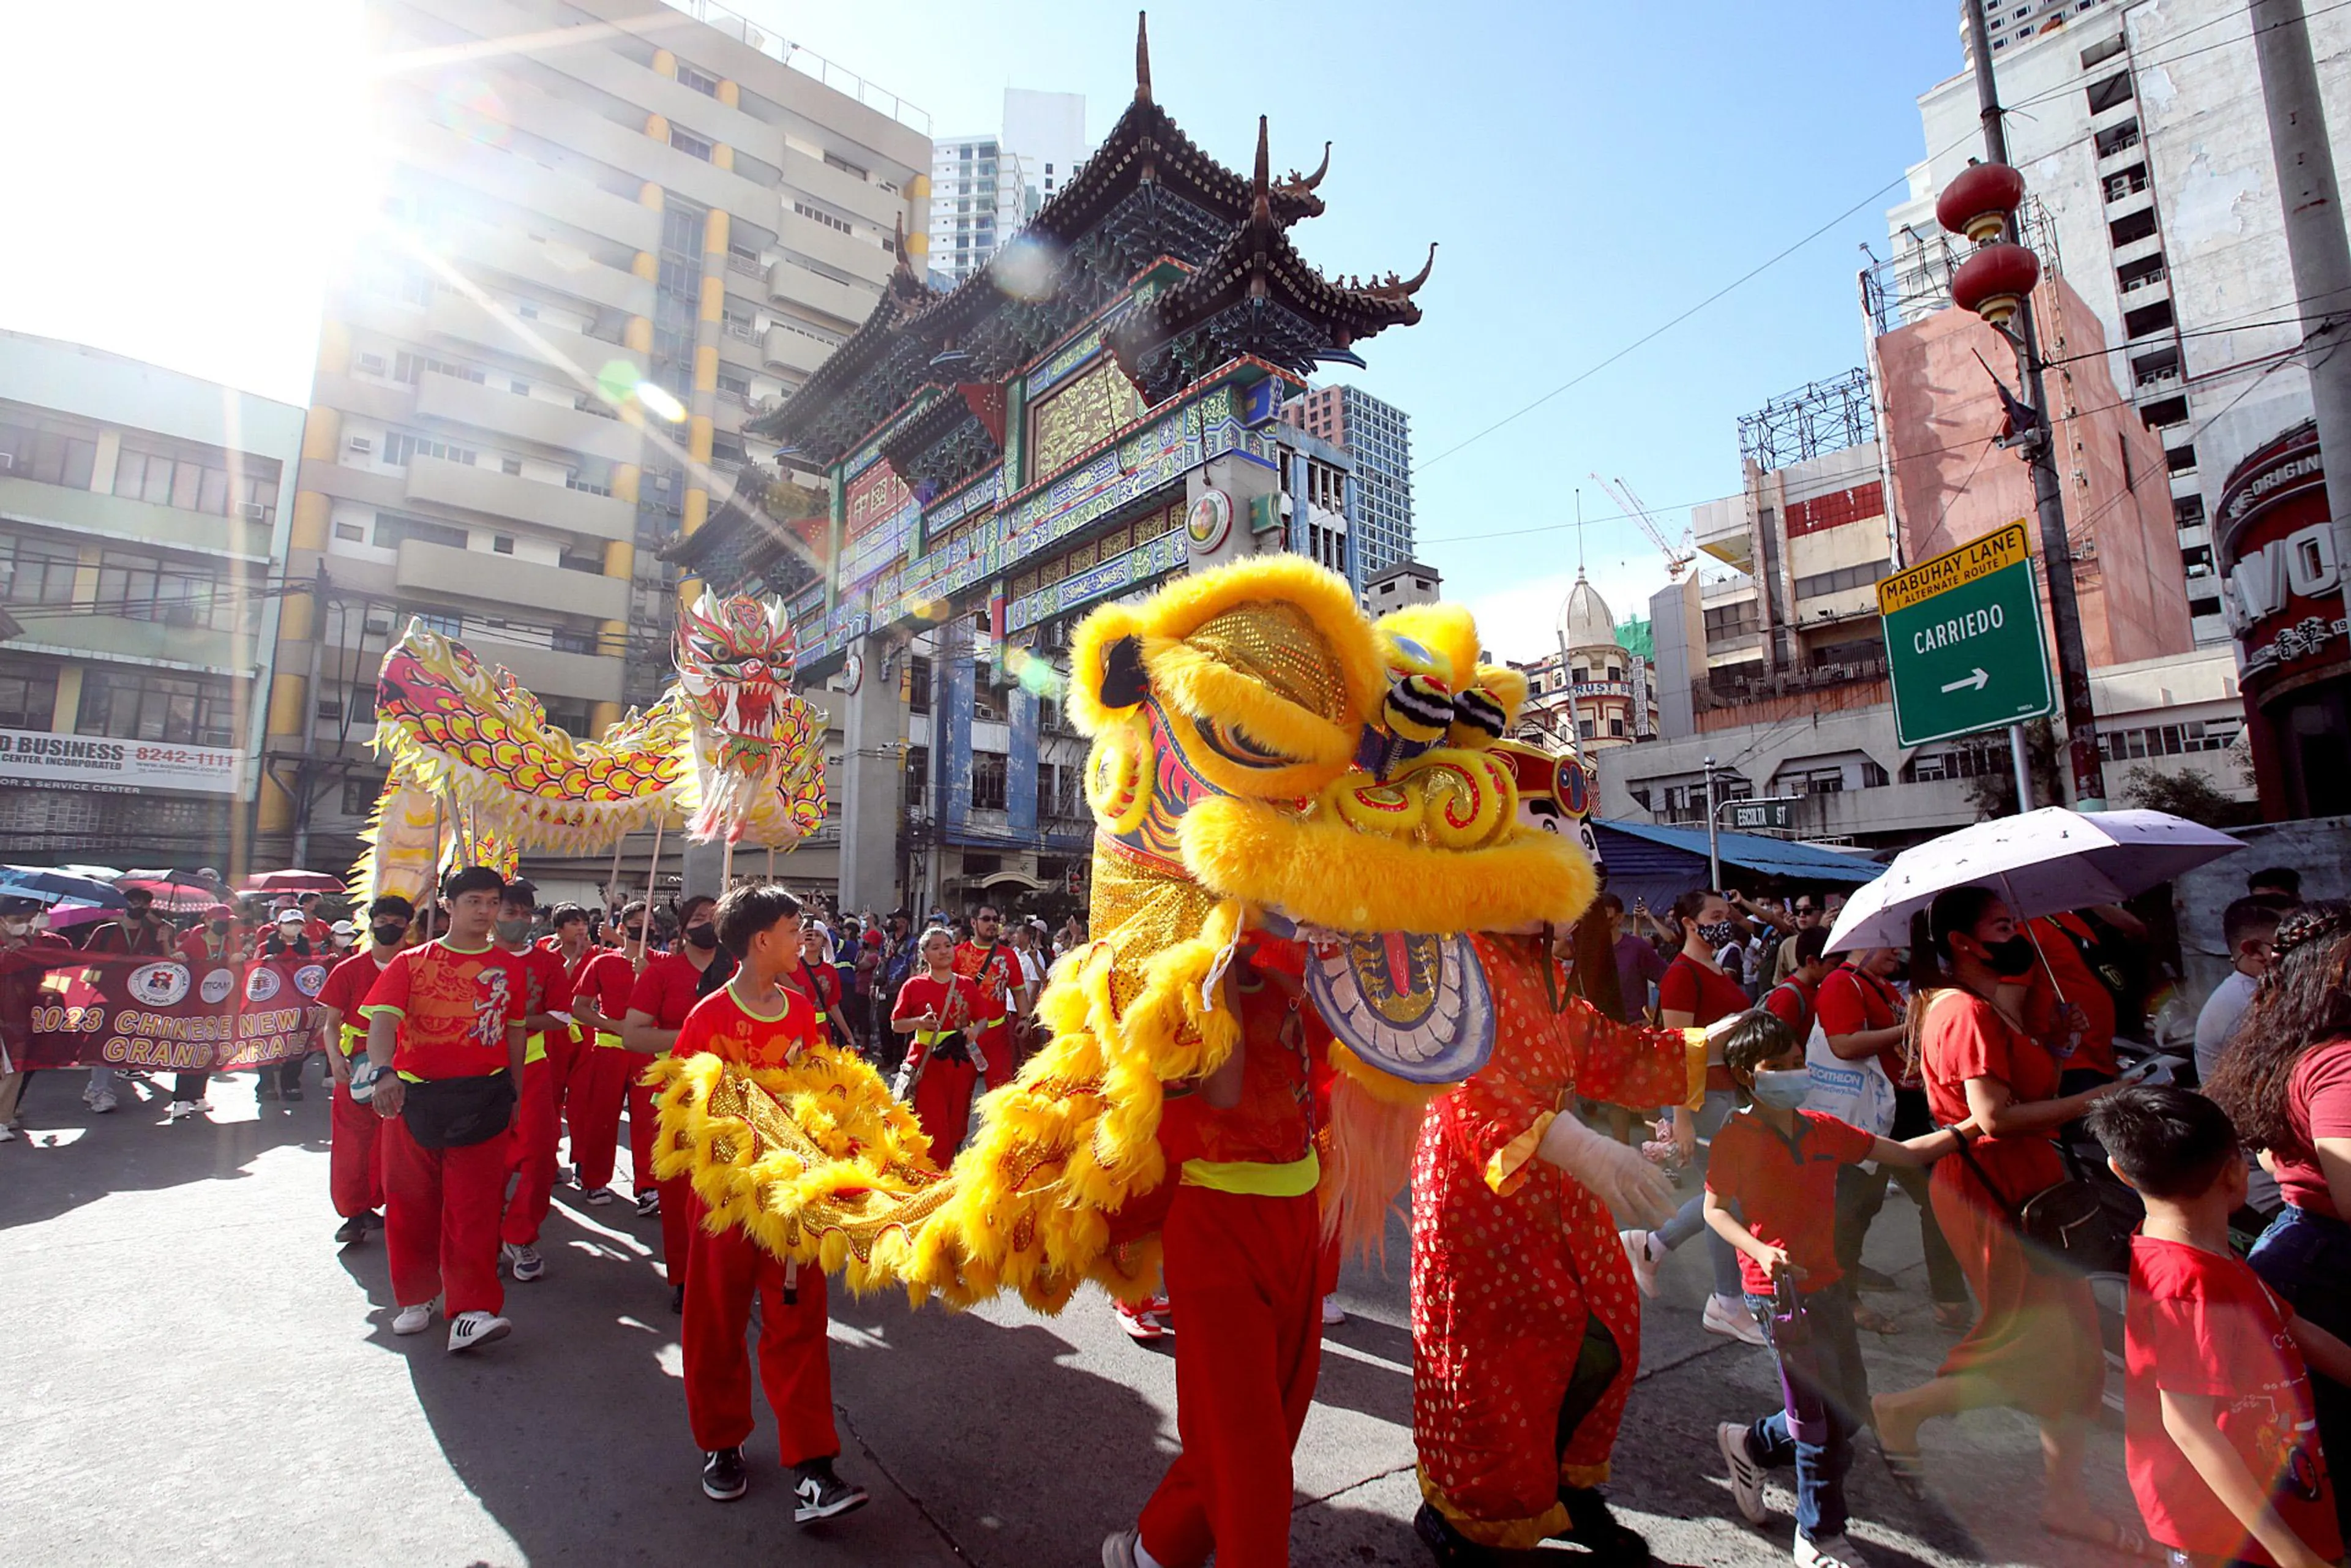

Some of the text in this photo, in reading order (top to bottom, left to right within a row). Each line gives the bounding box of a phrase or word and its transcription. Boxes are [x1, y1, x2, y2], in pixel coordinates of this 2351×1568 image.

[2252, 454, 2322, 497] ORIGIN
[1886, 531, 2016, 600] MABUHAY LANE
[1905, 575, 1959, 605] ALTERNATE
[1963, 558, 2000, 581] ROUTE
[1913, 604, 2004, 654] CARRIEDO
[2331, 620, 2347, 634] 19
[1574, 683, 1613, 694] RUST
[17, 736, 124, 761] BUSINESS
[135, 746, 234, 767] 8242-1111
[45, 757, 122, 771] INCORPORATED
[0, 778, 19, 787] OR
[36, 781, 89, 792] SERVICE
[92, 784, 140, 795] CENTER
[1737, 805, 1787, 827] ESCOLTA ST
[114, 1010, 232, 1041] CHINESE
[239, 1008, 302, 1038] NEW
[306, 1005, 328, 1029] YE
[102, 1031, 310, 1069] GRAND PARADE
